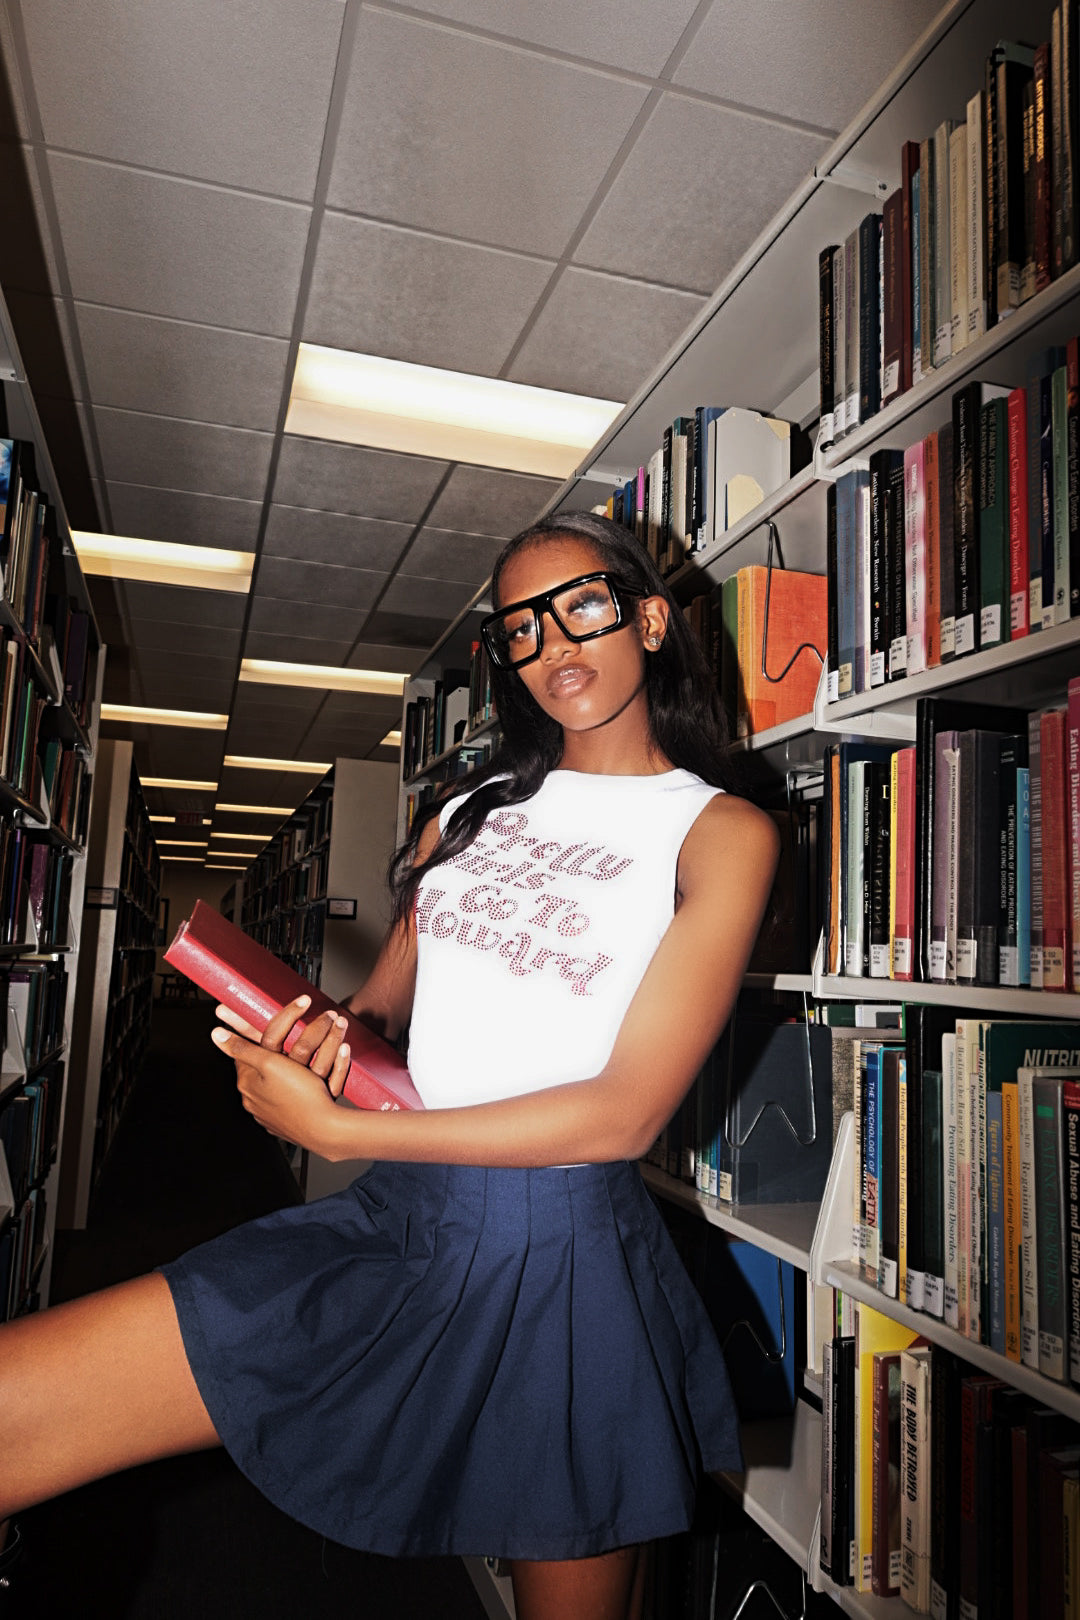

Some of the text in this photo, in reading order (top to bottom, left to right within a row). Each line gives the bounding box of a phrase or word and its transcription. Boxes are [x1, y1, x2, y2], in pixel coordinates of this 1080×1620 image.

[1011, 506, 1020, 537] Eating
[1012, 540, 1021, 585] Disorders
[1070, 729, 1080, 921] Eating Disorders and Obesity
[1008, 862, 1015, 870] OF
[949, 1125, 957, 1177] Preventing
[1069, 1112, 1079, 1157] Sexual
[868, 1160, 875, 1172] OF
[1069, 1160, 1079, 1200] Abuse
[949, 1180, 957, 1210] Eating
[1069, 1204, 1079, 1229] and
[949, 1212, 957, 1263] Disorders
[1070, 1232, 1080, 1274] Eating
[907, 1384, 917, 1406] THE
[907, 1408, 917, 1442] BODY
[907, 1441, 917, 1502] BETRAYED
